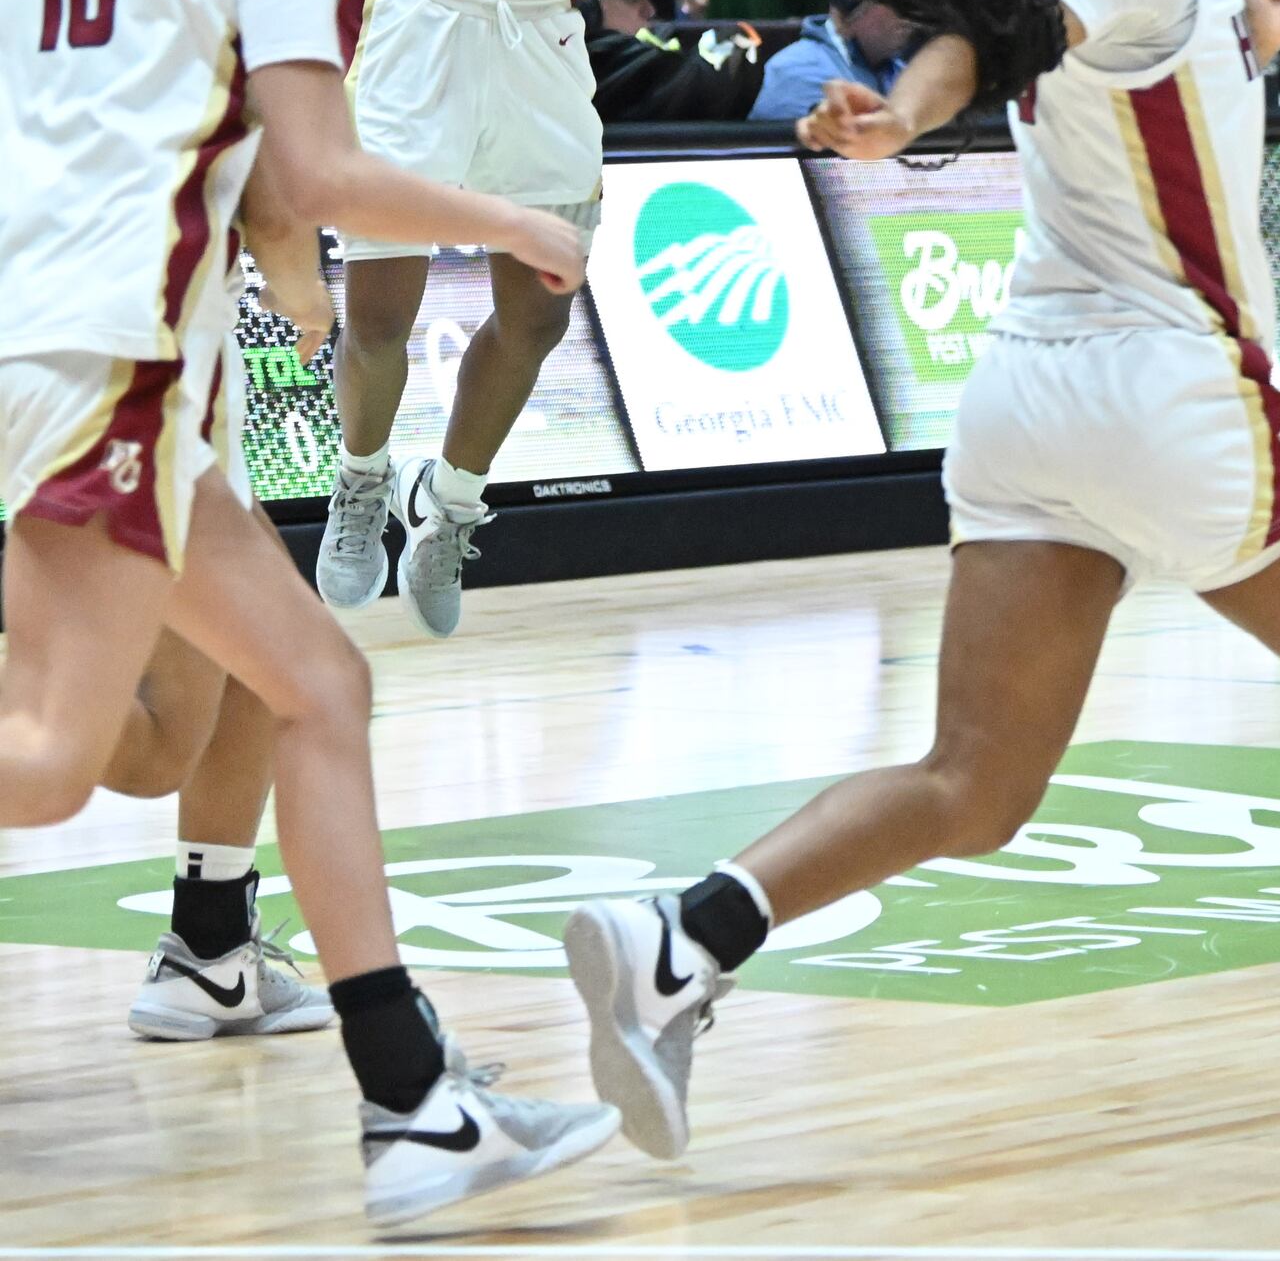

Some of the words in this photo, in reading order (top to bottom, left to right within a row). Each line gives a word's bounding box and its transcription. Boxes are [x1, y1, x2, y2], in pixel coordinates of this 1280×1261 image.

[655, 401, 772, 444] Georgia
[533, 479, 612, 498] DAKTRONICS
[789, 916, 1207, 974] PEST
